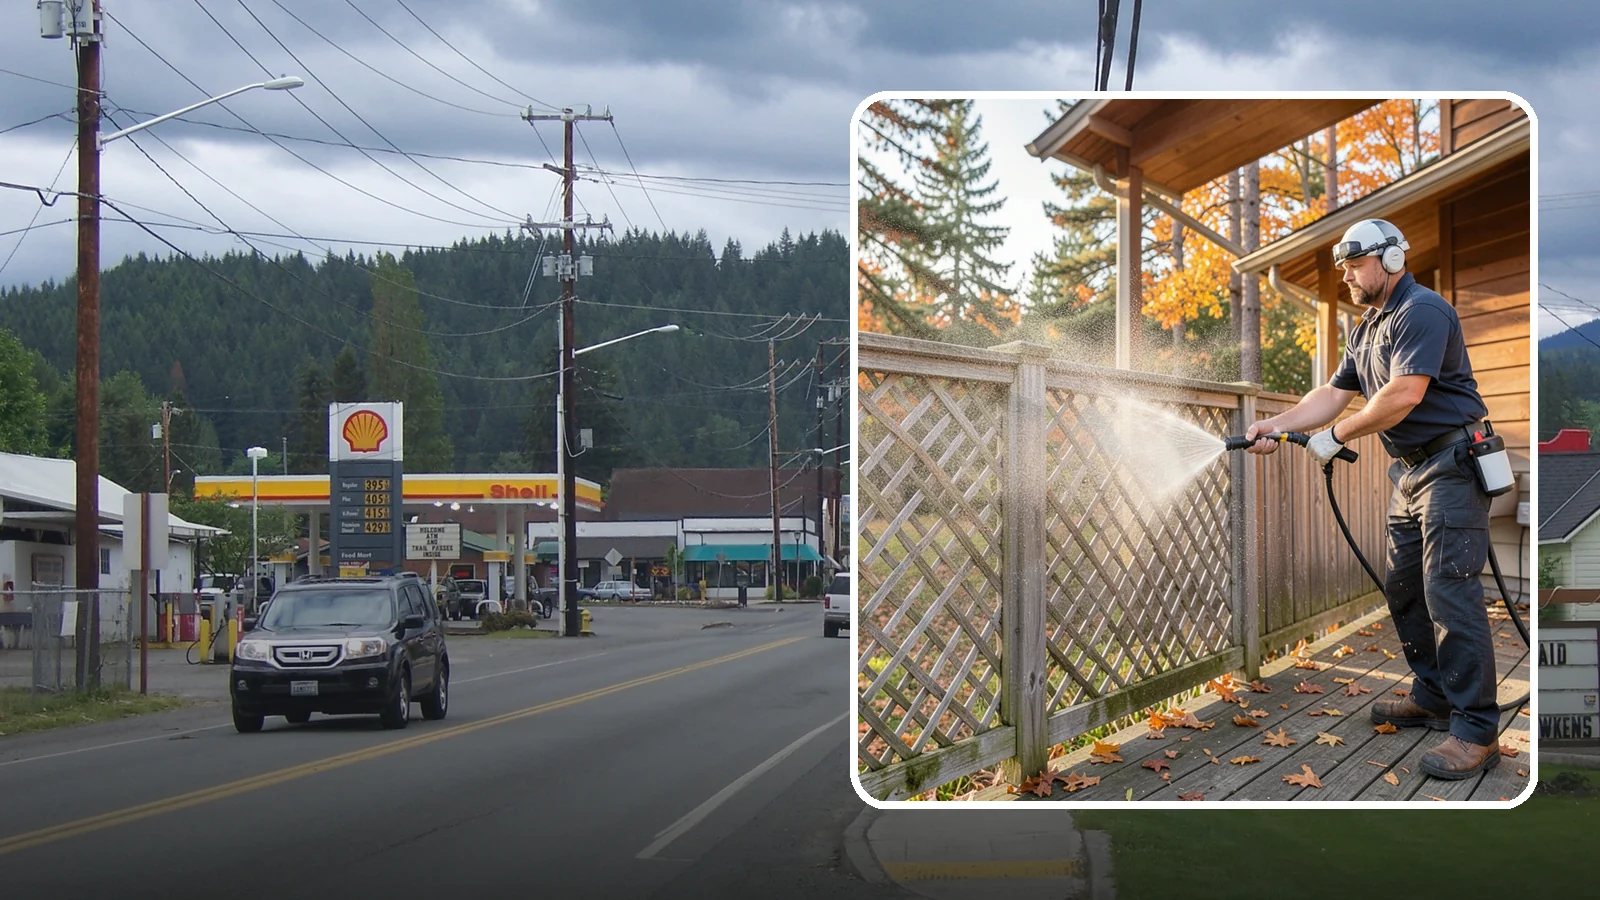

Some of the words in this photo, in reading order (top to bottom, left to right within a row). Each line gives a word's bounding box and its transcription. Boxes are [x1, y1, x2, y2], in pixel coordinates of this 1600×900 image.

[366, 480, 383, 490] 395
[490, 484, 547, 499] Shell
[366, 494, 383, 504] 405
[366, 508, 383, 518] 415
[366, 522, 383, 532] 429
[1538, 643, 1567, 665] AID
